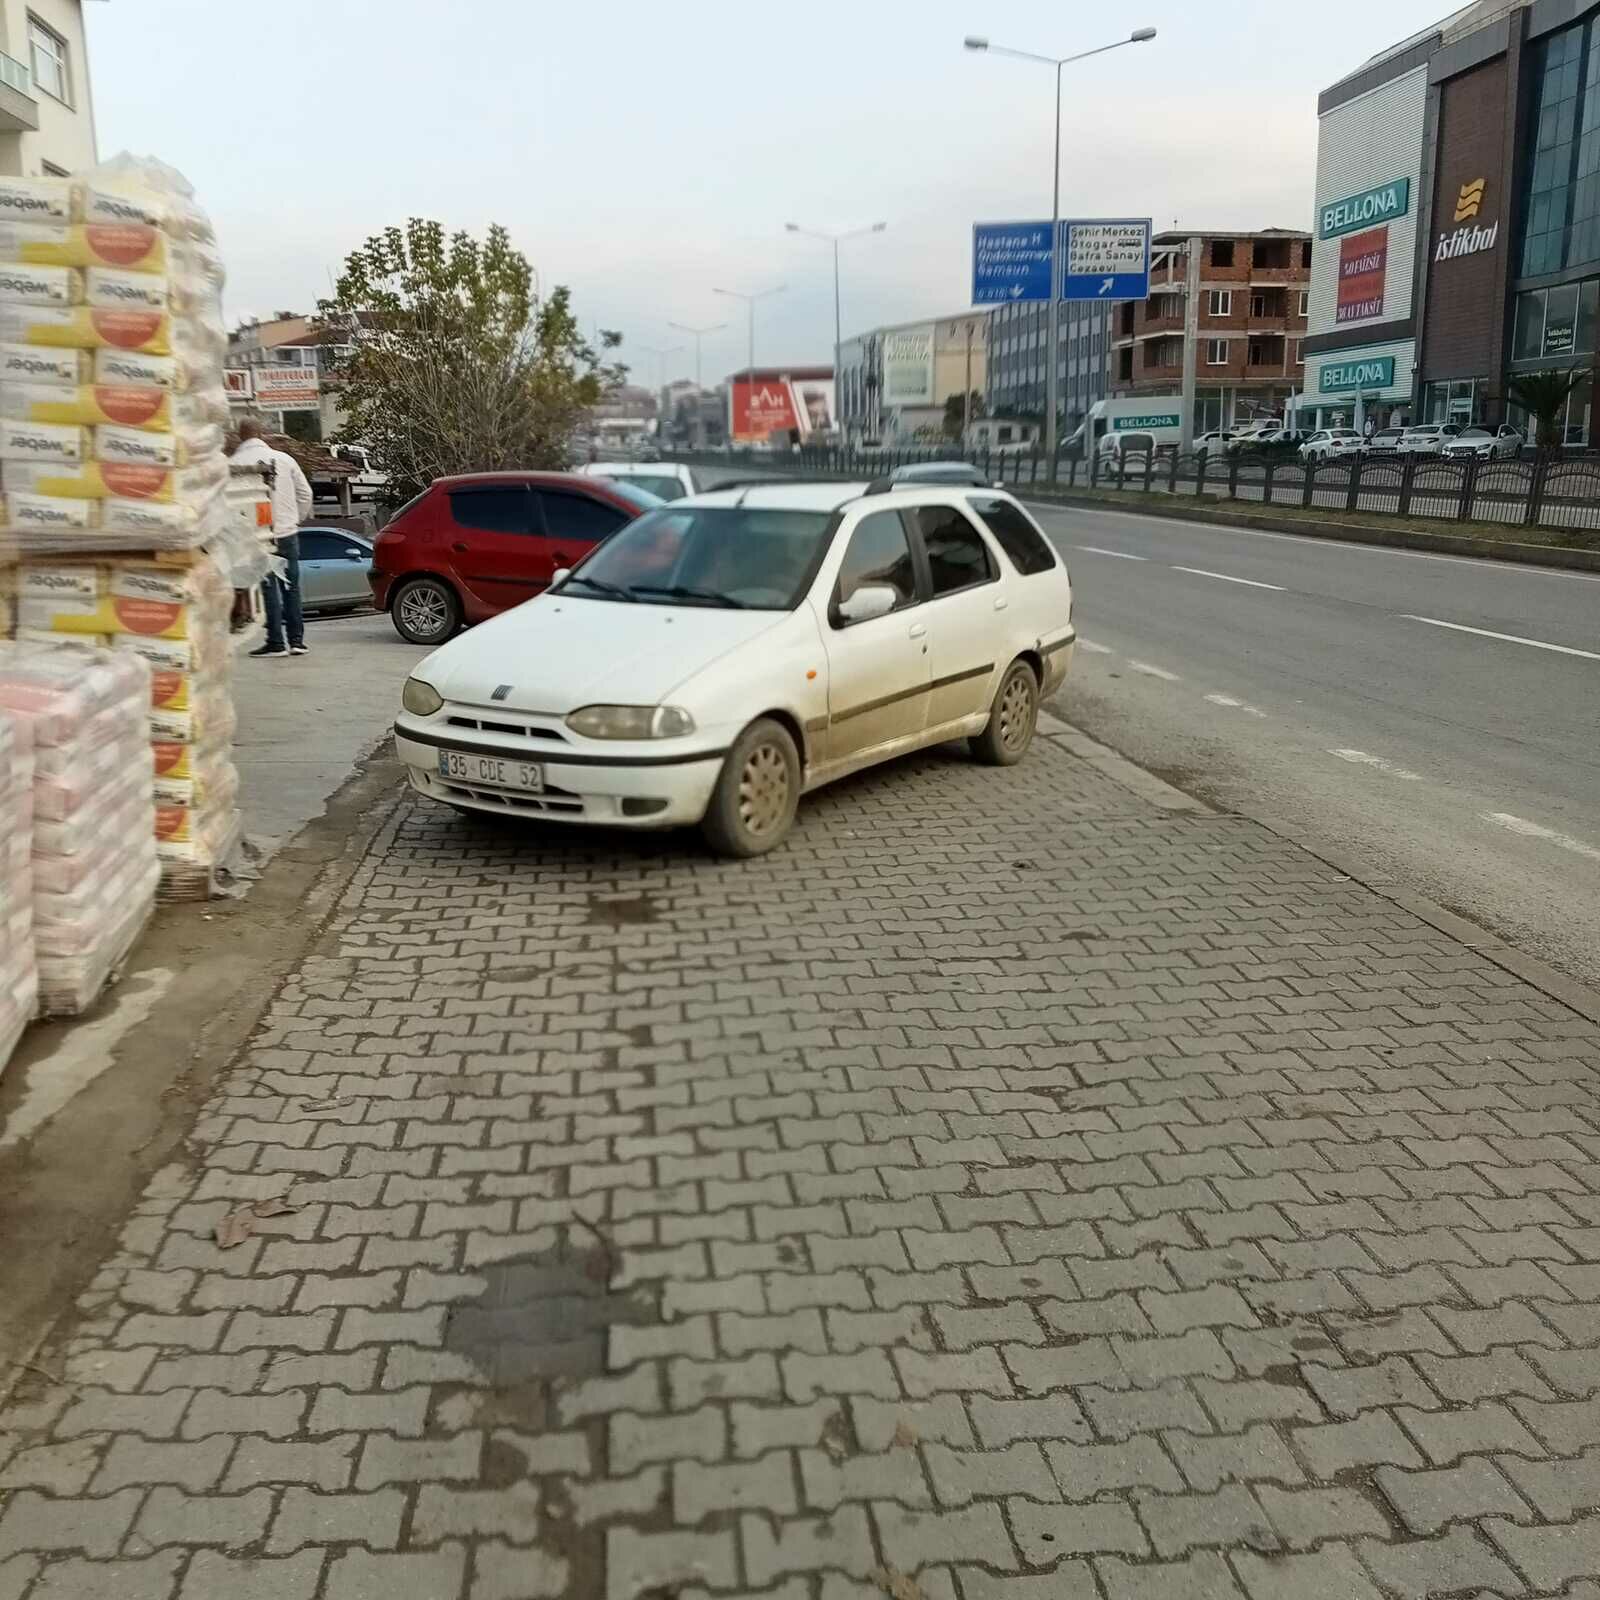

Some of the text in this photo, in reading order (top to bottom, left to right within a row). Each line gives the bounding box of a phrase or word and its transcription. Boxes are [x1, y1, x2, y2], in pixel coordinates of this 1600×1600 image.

[1323, 188, 1399, 232] BELLONA
[1071, 227, 1145, 239] Şehir Merkezi
[1071, 240, 1115, 250] Otogar
[1070, 250, 1144, 262] Bafra Sanayi
[1070, 263, 1117, 273] Cezaevi
[0, 278, 49, 294] webe
[6, 358, 61, 374] weber
[1323, 362, 1384, 387] BELLONA
[1119, 415, 1174, 428] BELLONA
[10, 435, 64, 451] weber
[106, 439, 157, 456] weber
[18, 507, 70, 522] weber
[28, 575, 79, 589] weber
[450, 754, 539, 787] 35 CDE 52
